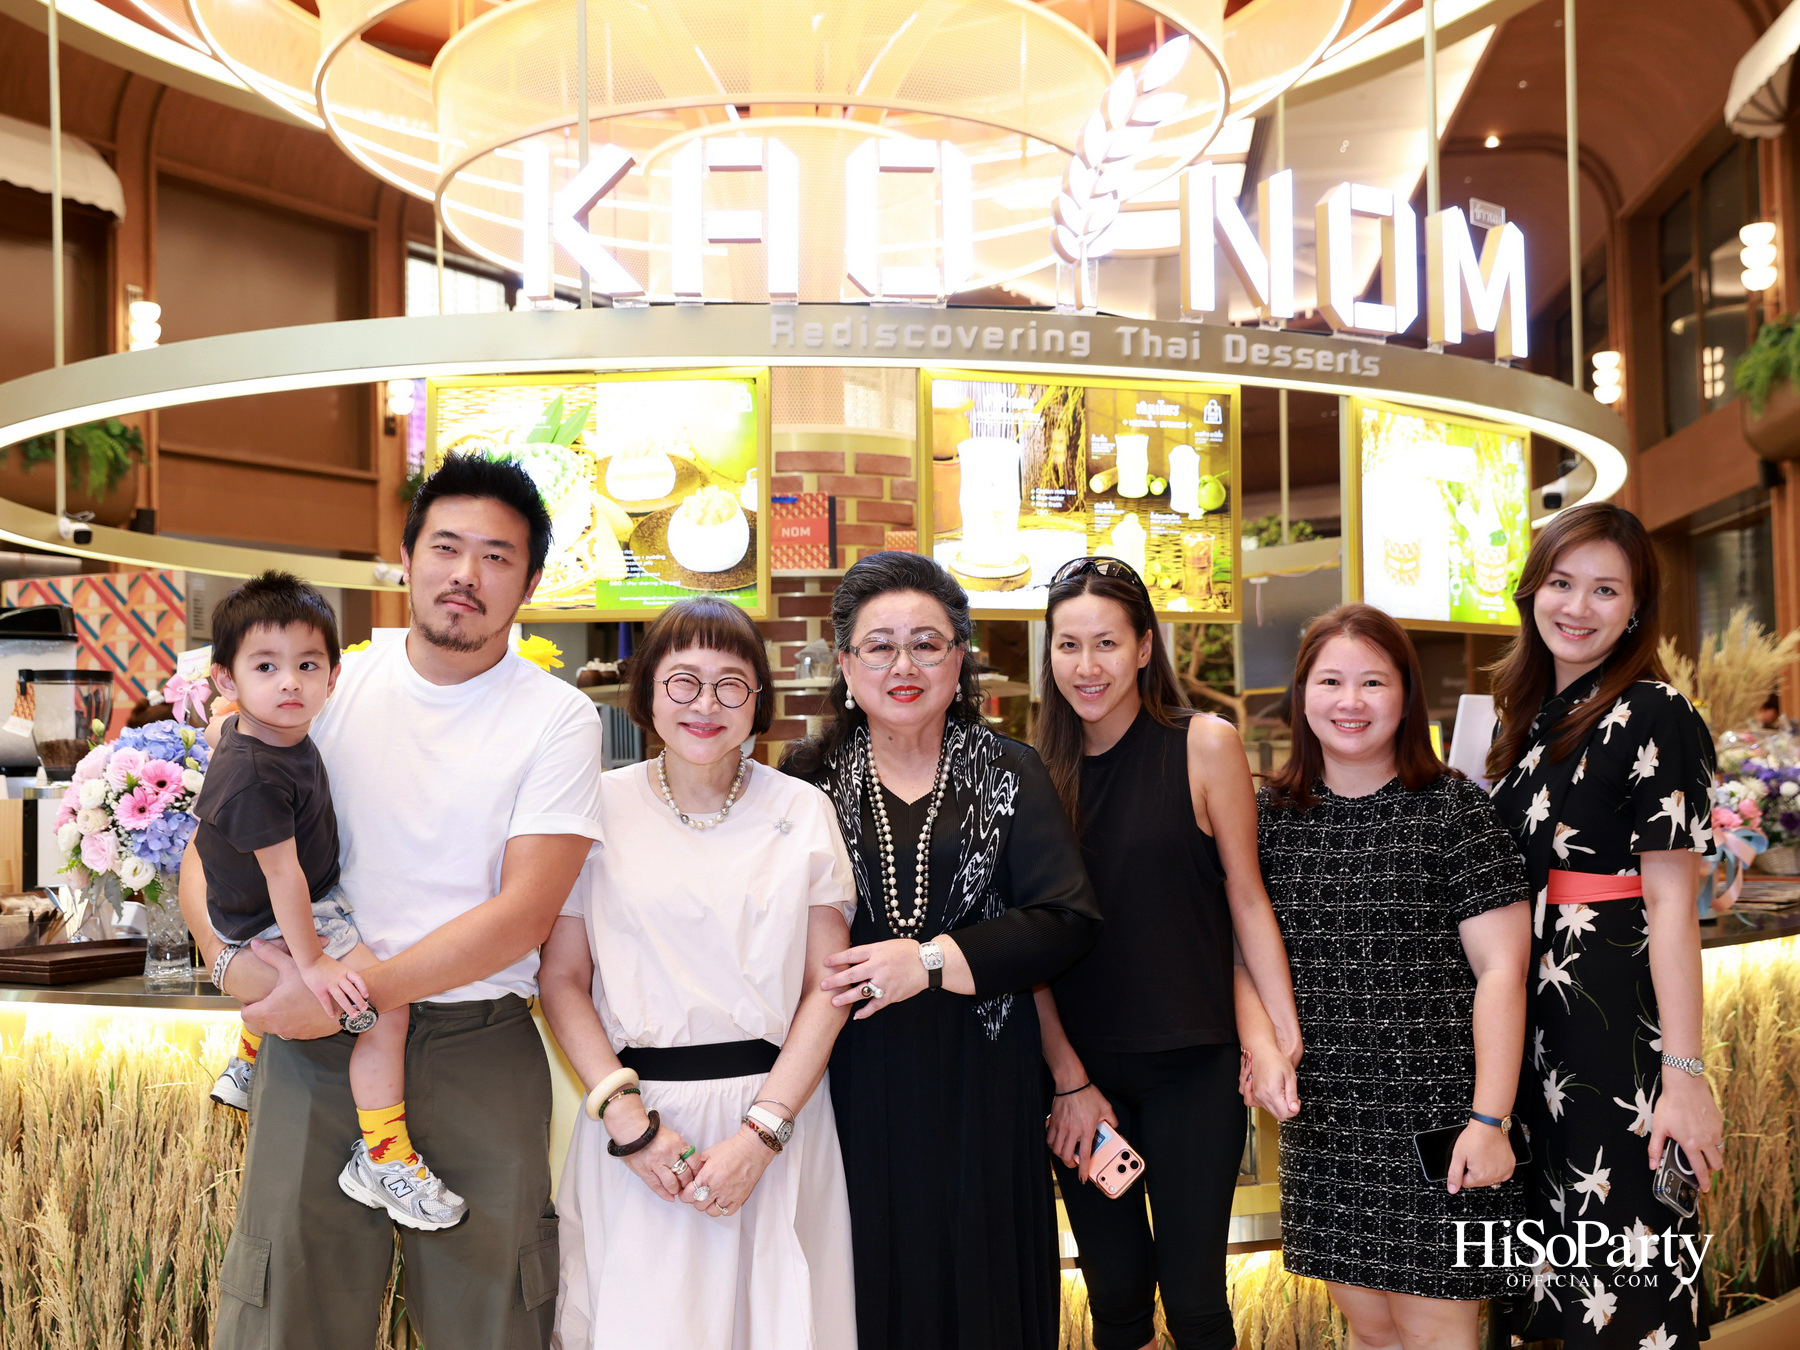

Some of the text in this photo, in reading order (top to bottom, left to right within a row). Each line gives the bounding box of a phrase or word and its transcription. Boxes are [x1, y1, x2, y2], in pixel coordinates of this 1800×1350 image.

[522, 136, 1529, 360] KAO NOM
[769, 314, 1380, 377] Rediscovering Thai Desserts
[781, 526, 811, 538] NOM
[387, 1178, 414, 1199] N
